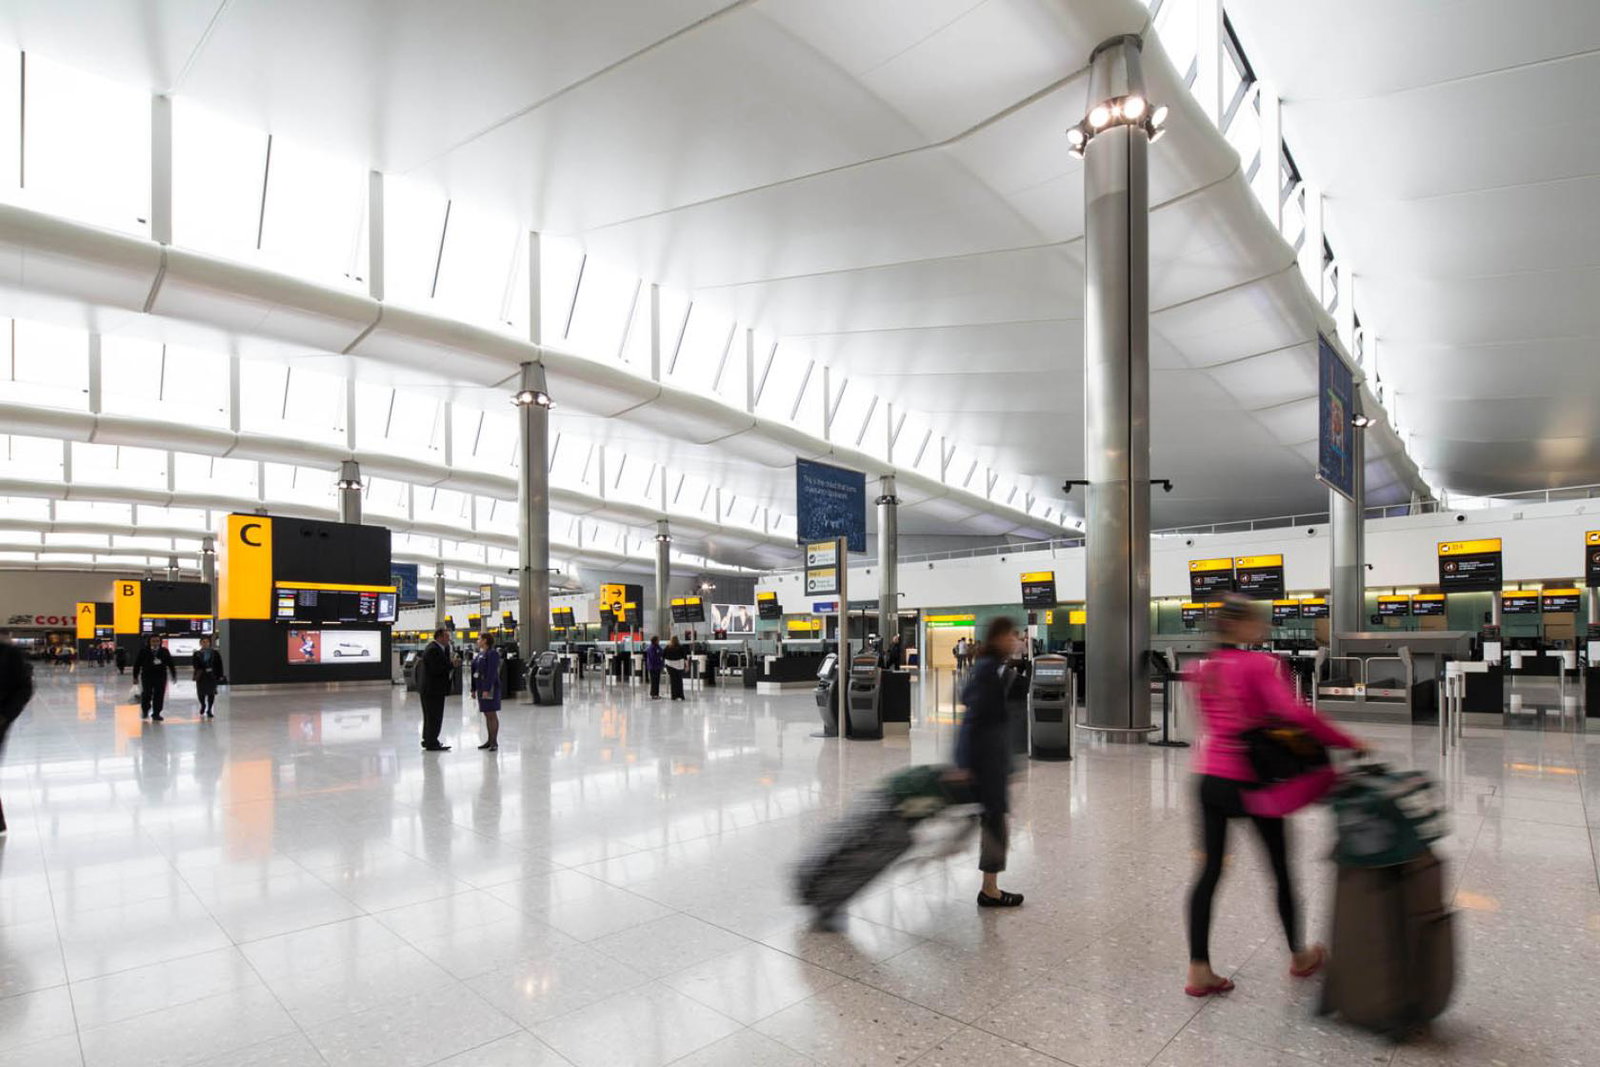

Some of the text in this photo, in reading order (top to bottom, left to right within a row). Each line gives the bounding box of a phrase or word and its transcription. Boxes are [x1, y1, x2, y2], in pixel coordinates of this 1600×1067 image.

[240, 523, 262, 547] C
[123, 584, 134, 596] B
[82, 605, 91, 614] A
